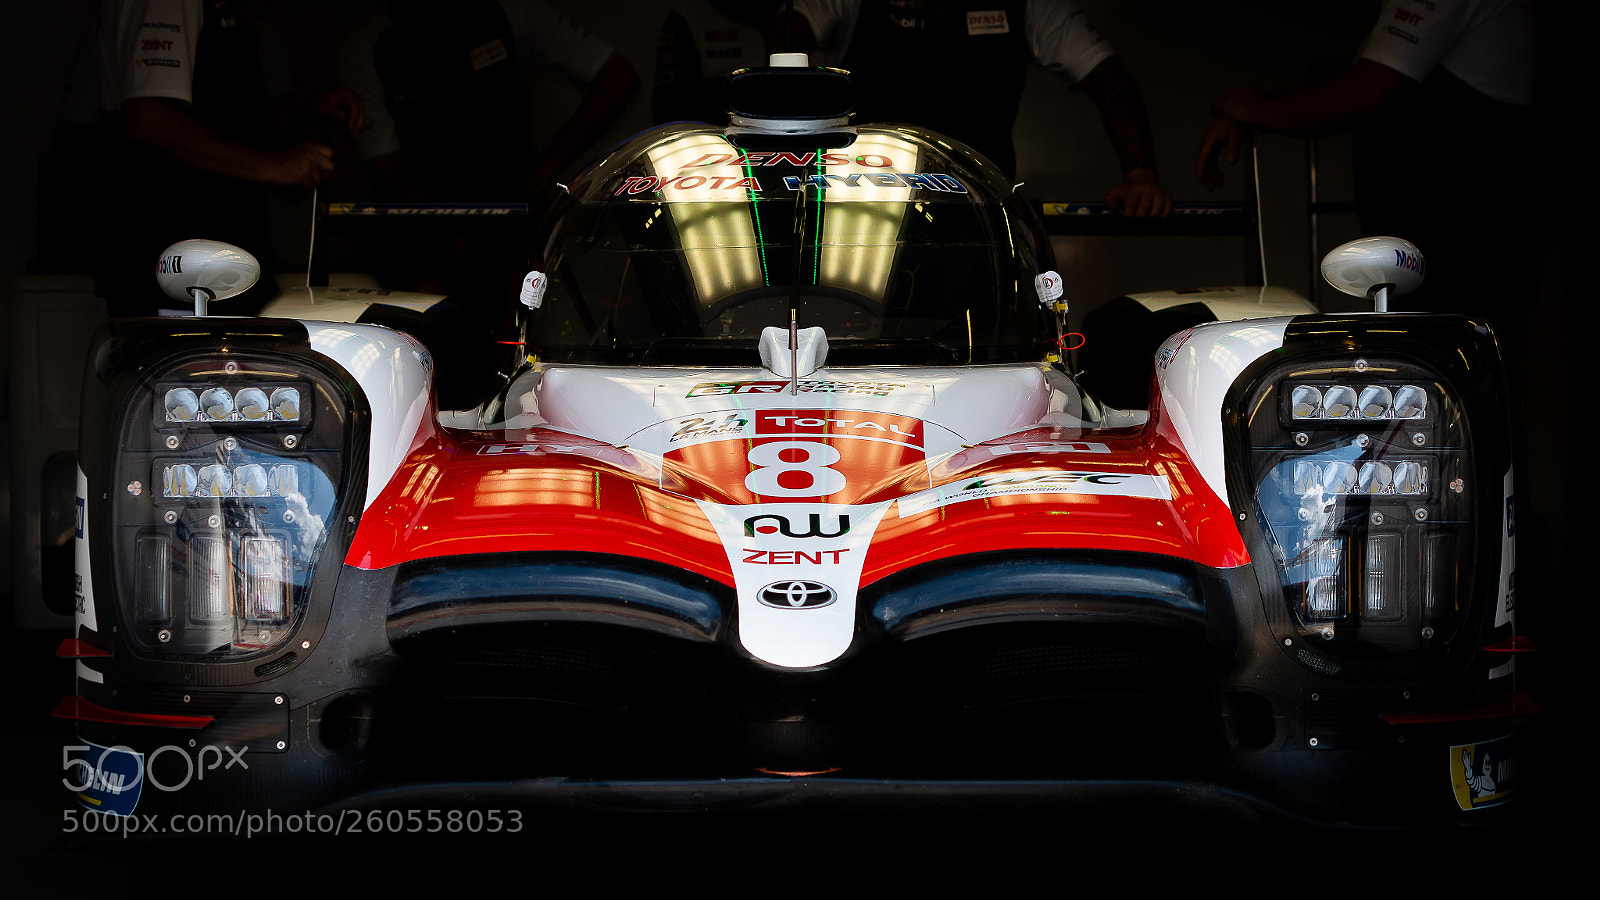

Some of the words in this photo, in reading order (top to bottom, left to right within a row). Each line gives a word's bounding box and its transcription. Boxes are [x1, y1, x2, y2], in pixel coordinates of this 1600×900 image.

[969, 16, 1004, 25] DENSO
[142, 40, 173, 51] ZENT
[680, 151, 895, 169] DENSO
[614, 176, 763, 196] TOYOTA
[782, 173, 969, 194] HYBRID
[387, 208, 511, 216] MICHELIN
[764, 415, 916, 438] TOTAL
[744, 440, 847, 498] 8
[742, 548, 850, 565] ZENT
